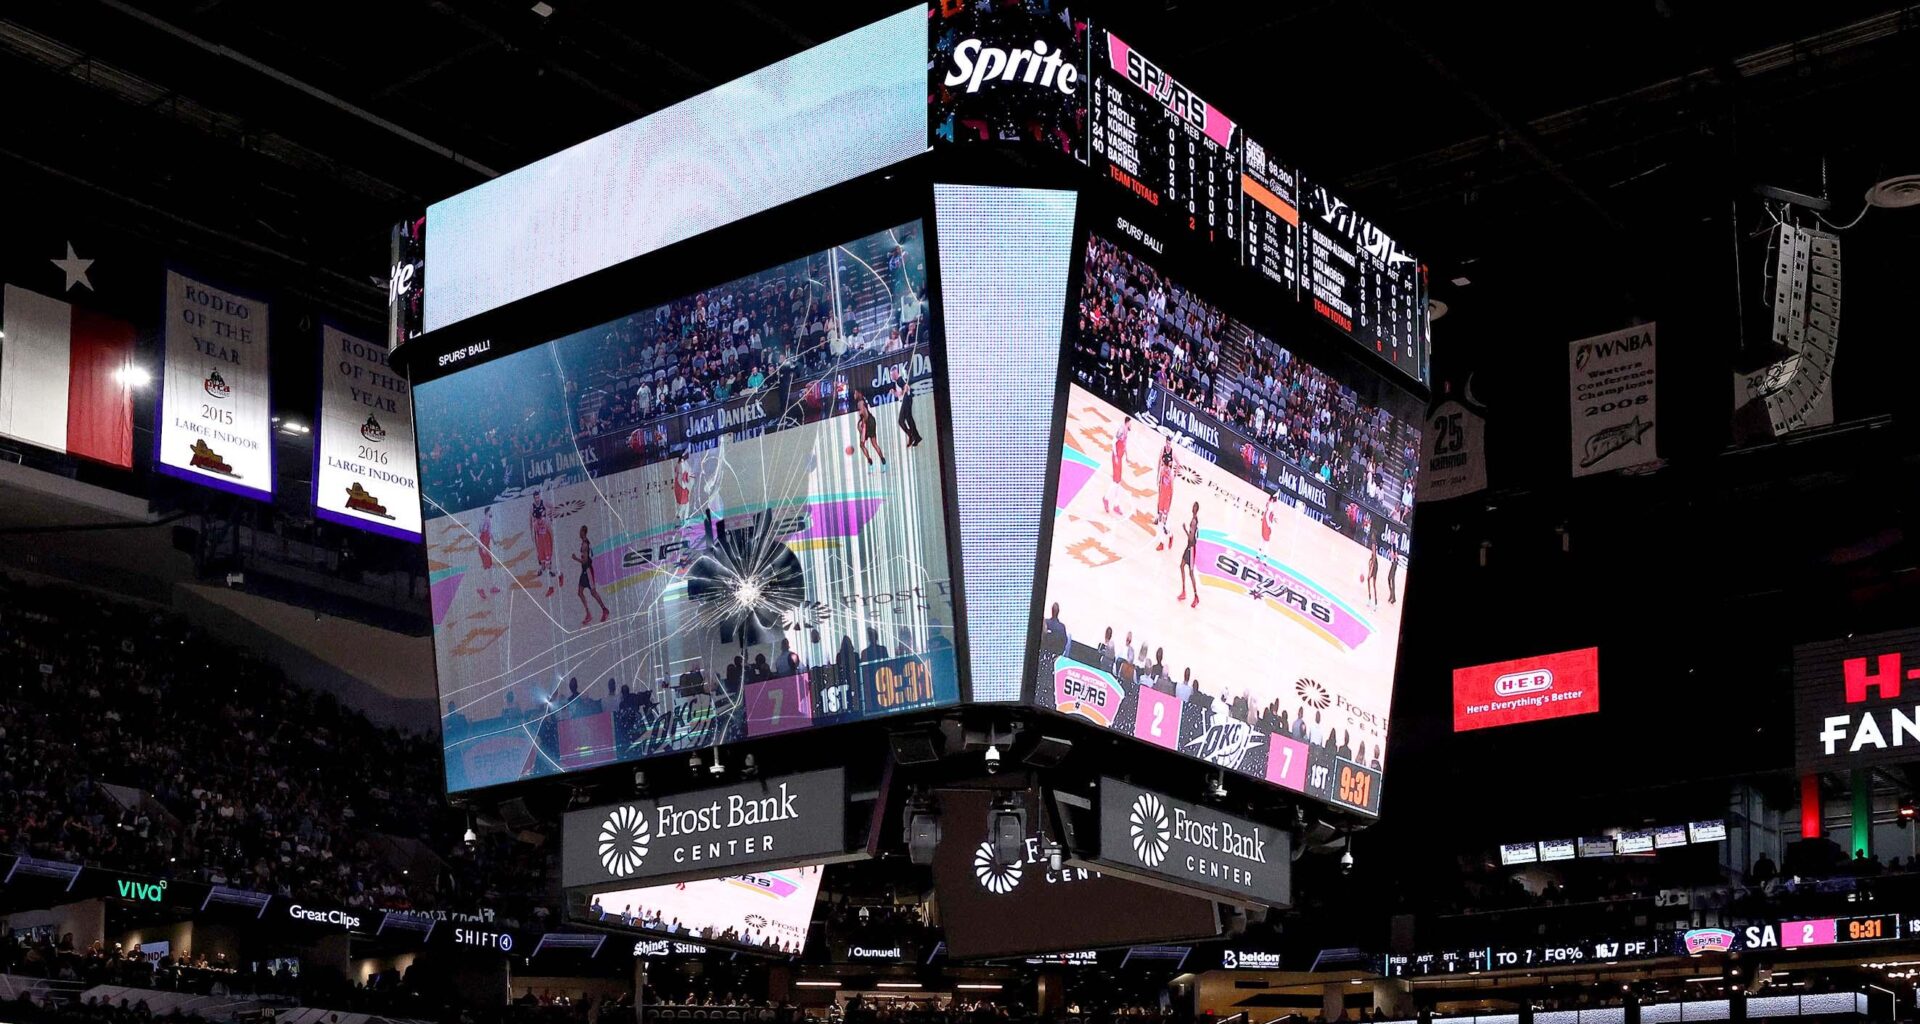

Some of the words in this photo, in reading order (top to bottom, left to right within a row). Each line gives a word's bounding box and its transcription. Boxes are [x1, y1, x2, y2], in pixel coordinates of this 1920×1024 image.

[944, 38, 1078, 95] Sprite
[1107, 85, 1123, 106] FOX
[1126, 46, 1208, 132] SPURS
[1107, 101, 1136, 130] CASTLE
[1092, 121, 1104, 139] 24
[1107, 131, 1140, 164] VASSELL
[1107, 116, 1138, 145] KORNET
[1164, 108, 1179, 126] PTS
[1184, 122, 1199, 140] REB
[1203, 137, 1219, 153] AST
[1225, 151, 1235, 164] PF
[1092, 138, 1104, 153] 40
[1107, 146, 1138, 176] BARNES
[1110, 164, 1130, 188] TEAM
[1131, 179, 1158, 206] TOTALS
[1116, 217, 1143, 242] SPURS'
[1143, 231, 1164, 254] BALL!
[1312, 242, 1329, 263] DORT
[1372, 256, 1384, 272] REB
[185, 284, 249, 320] RODEO
[183, 309, 206, 328] OF
[212, 320, 252, 345] THE
[193, 336, 241, 365] YEAR
[341, 339, 391, 368] RODE
[438, 347, 468, 367] SPURS'
[468, 339, 491, 356] BALL!
[1594, 331, 1653, 359] WNBA
[340, 361, 364, 379] OF
[368, 370, 408, 394] THE
[1577, 369, 1654, 391] Conference
[1588, 362, 1642, 379] Western
[350, 385, 397, 414] YEAR
[1578, 379, 1654, 401] Champions
[201, 403, 234, 426] 2015
[1166, 402, 1187, 427] JACK
[1584, 394, 1649, 417] 2008
[175, 417, 212, 439] LARGE
[213, 429, 258, 451] INDOOR
[685, 414, 716, 438] JACK
[1434, 412, 1463, 456] 25
[358, 445, 388, 466] 2016
[527, 456, 554, 480] JACK
[327, 455, 366, 476] LARGE
[368, 467, 415, 489] INDOOR
[1278, 466, 1299, 491] JACK
[1216, 554, 1330, 624] SPURS
[767, 688, 784, 726] 7
[820, 684, 850, 713] 1ST
[874, 657, 933, 708] 9:31
[1063, 678, 1107, 707] SPURS
[1466, 704, 1489, 714] Here
[1491, 694, 1549, 710] Everything's
[1551, 690, 1583, 702] Better
[1203, 724, 1242, 751] OKC
[1820, 705, 1920, 755] FAN
[1150, 701, 1166, 738] 2
[1280, 747, 1294, 780] 7
[1310, 763, 1329, 790] 1ST
[1339, 765, 1371, 807] 9:31
[656, 800, 721, 838] Frost
[727, 782, 799, 828] Bank
[673, 834, 774, 863] CENTER
[1174, 807, 1219, 850] Frost
[1221, 821, 1266, 864] Bank
[1186, 855, 1252, 886] CENTER
[289, 904, 327, 922] Great
[328, 909, 361, 929] Clips
[1692, 936, 1722, 946] SPURS
[1745, 924, 1778, 949] SA
[1802, 923, 1815, 944] 2
[1849, 919, 1882, 940] 9:31
[853, 946, 901, 958] Ownwell
[1239, 951, 1280, 962] beldon
[1389, 956, 1408, 964] REB
[1416, 954, 1434, 963] AST
[1443, 952, 1460, 961] STL
[1468, 950, 1485, 959] BLK
[1496, 952, 1518, 965] TO
[1525, 949, 1533, 964] 7
[1544, 946, 1583, 961] FG%
[1624, 941, 1646, 956] PF
